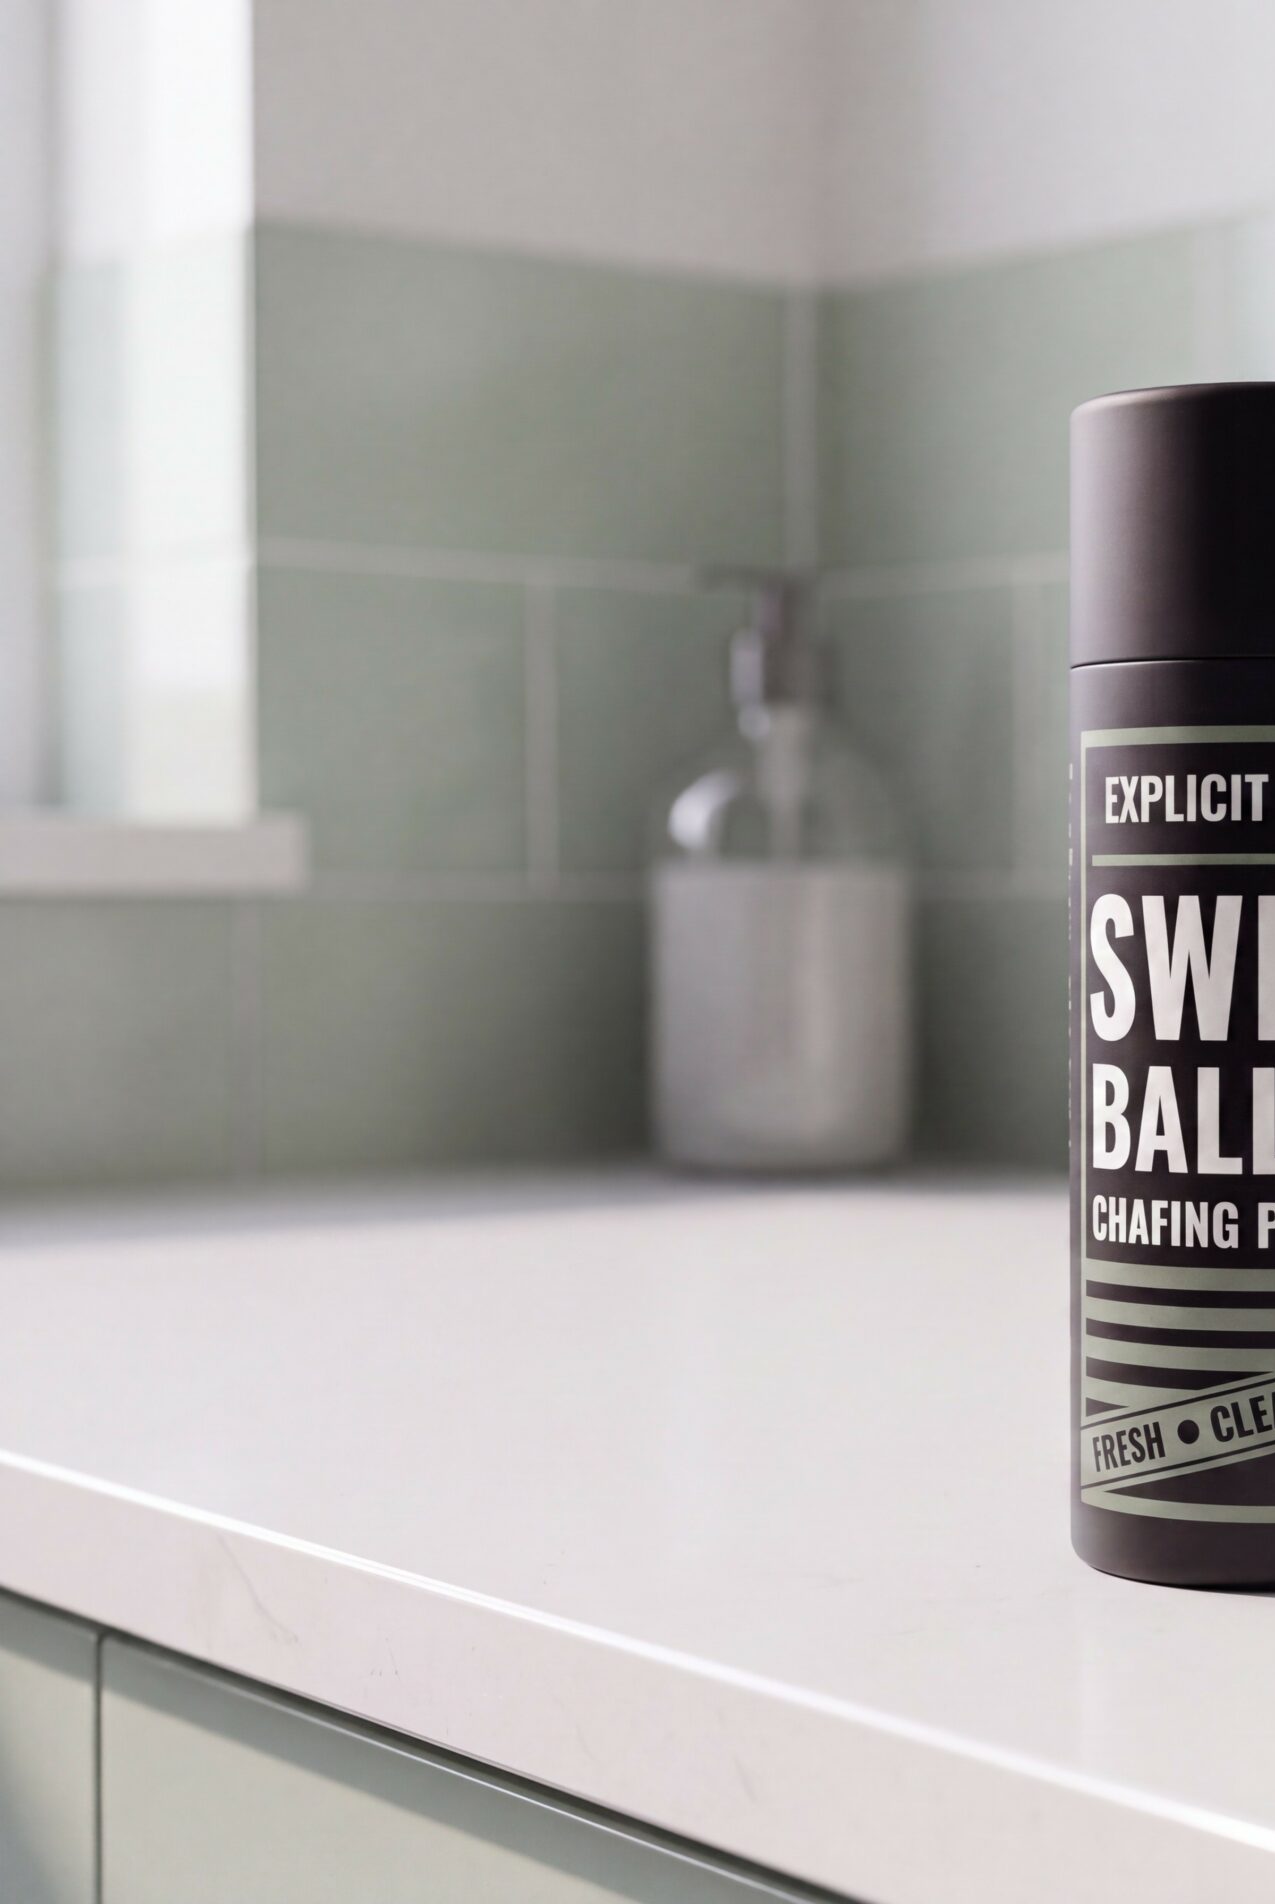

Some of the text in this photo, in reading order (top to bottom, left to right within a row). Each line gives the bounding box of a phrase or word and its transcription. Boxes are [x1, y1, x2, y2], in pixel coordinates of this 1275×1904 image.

[1105, 773, 1269, 824] EXPLICIT
[1092, 1194, 1239, 1249] CHAFING
[1092, 1421, 1166, 1473] FRESH
